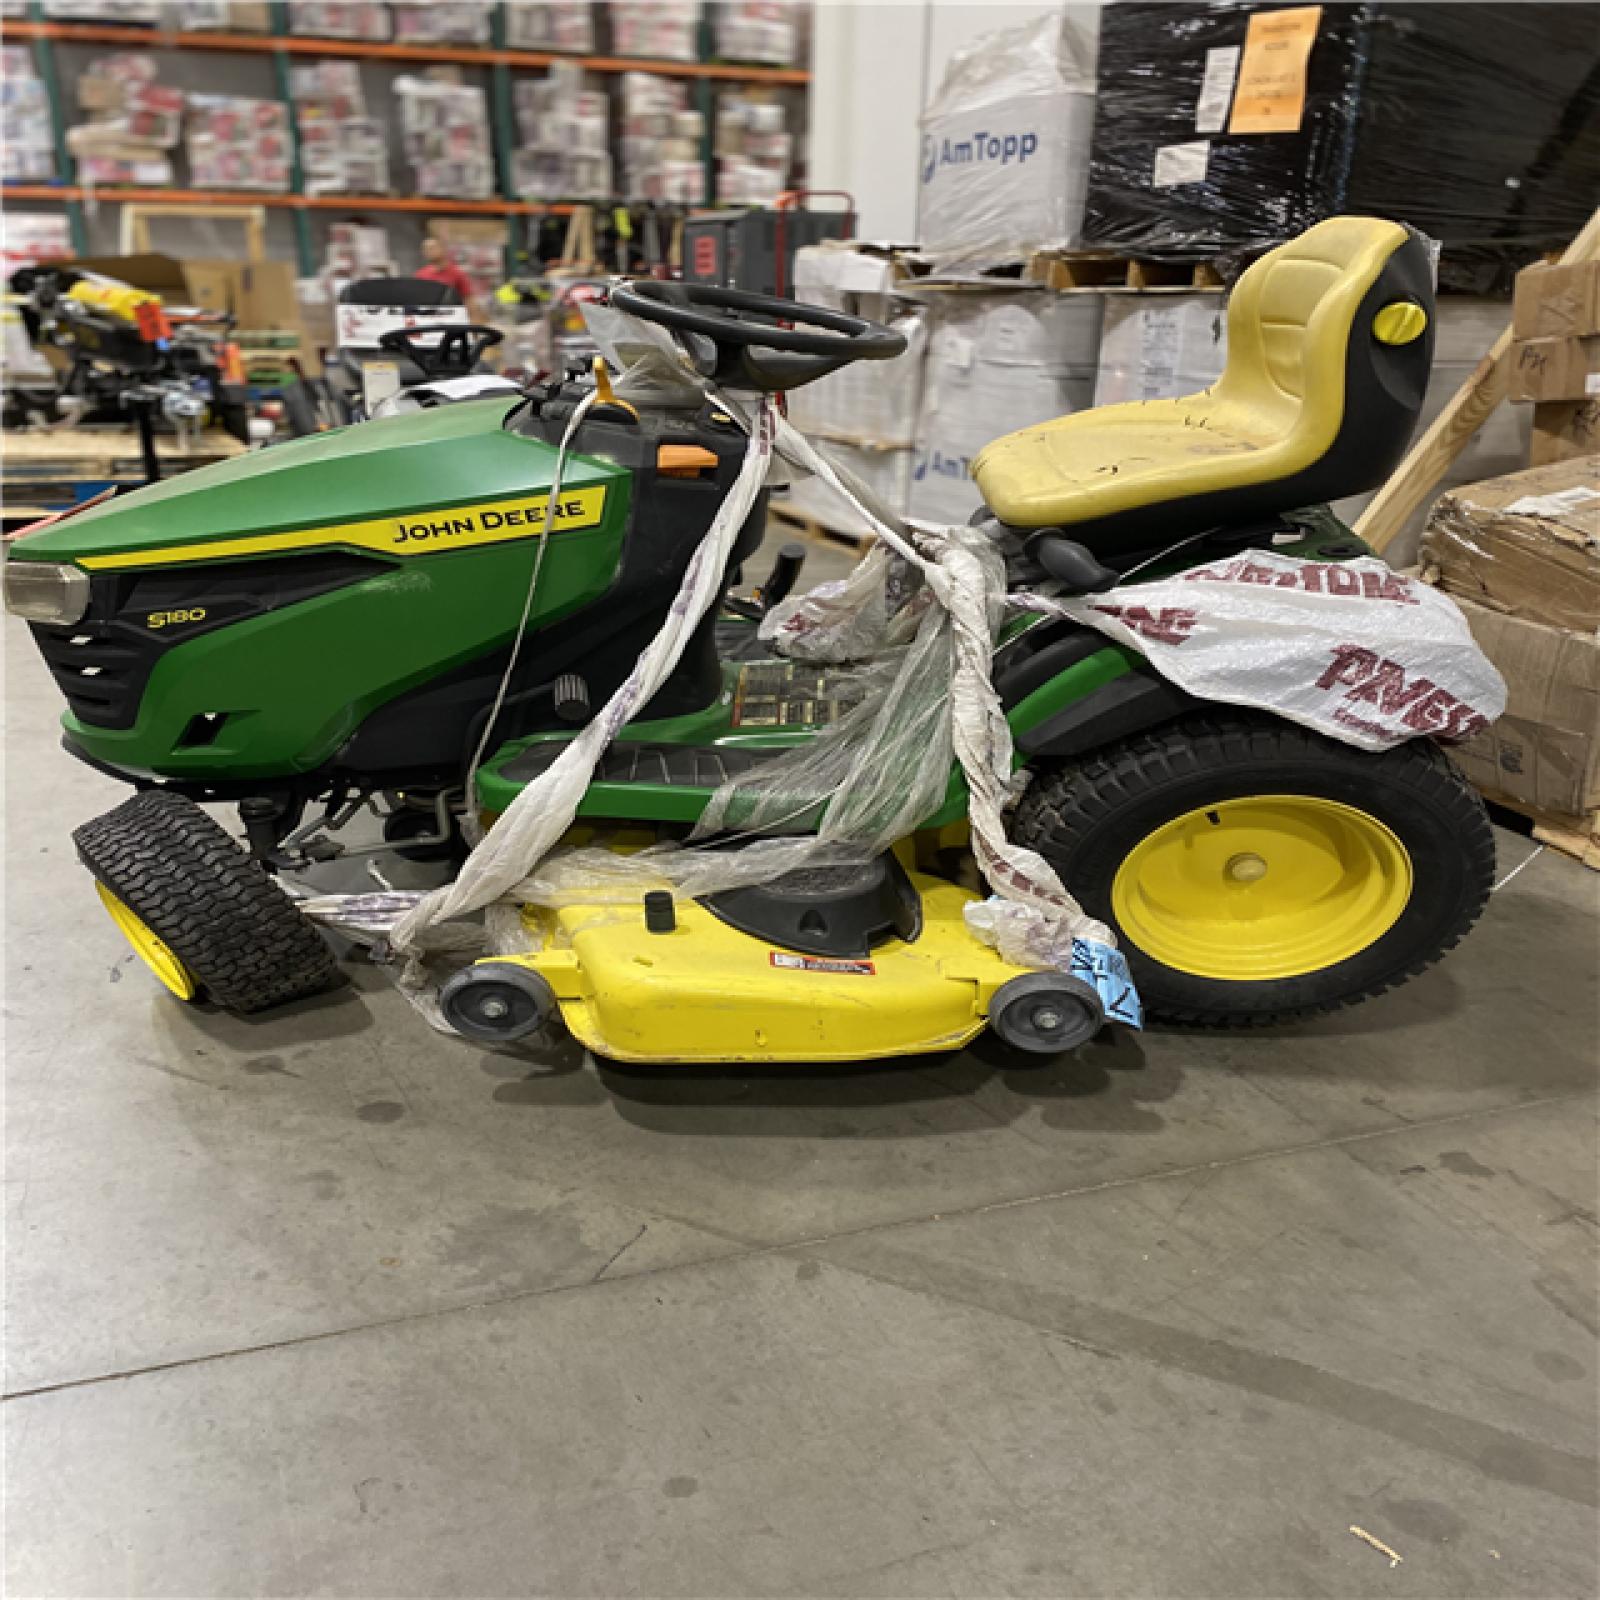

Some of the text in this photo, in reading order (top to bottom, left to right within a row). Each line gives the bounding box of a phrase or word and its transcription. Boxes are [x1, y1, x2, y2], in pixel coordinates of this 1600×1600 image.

[940, 131, 1038, 166] AmTopp
[392, 500, 585, 543] JOHN DEERE
